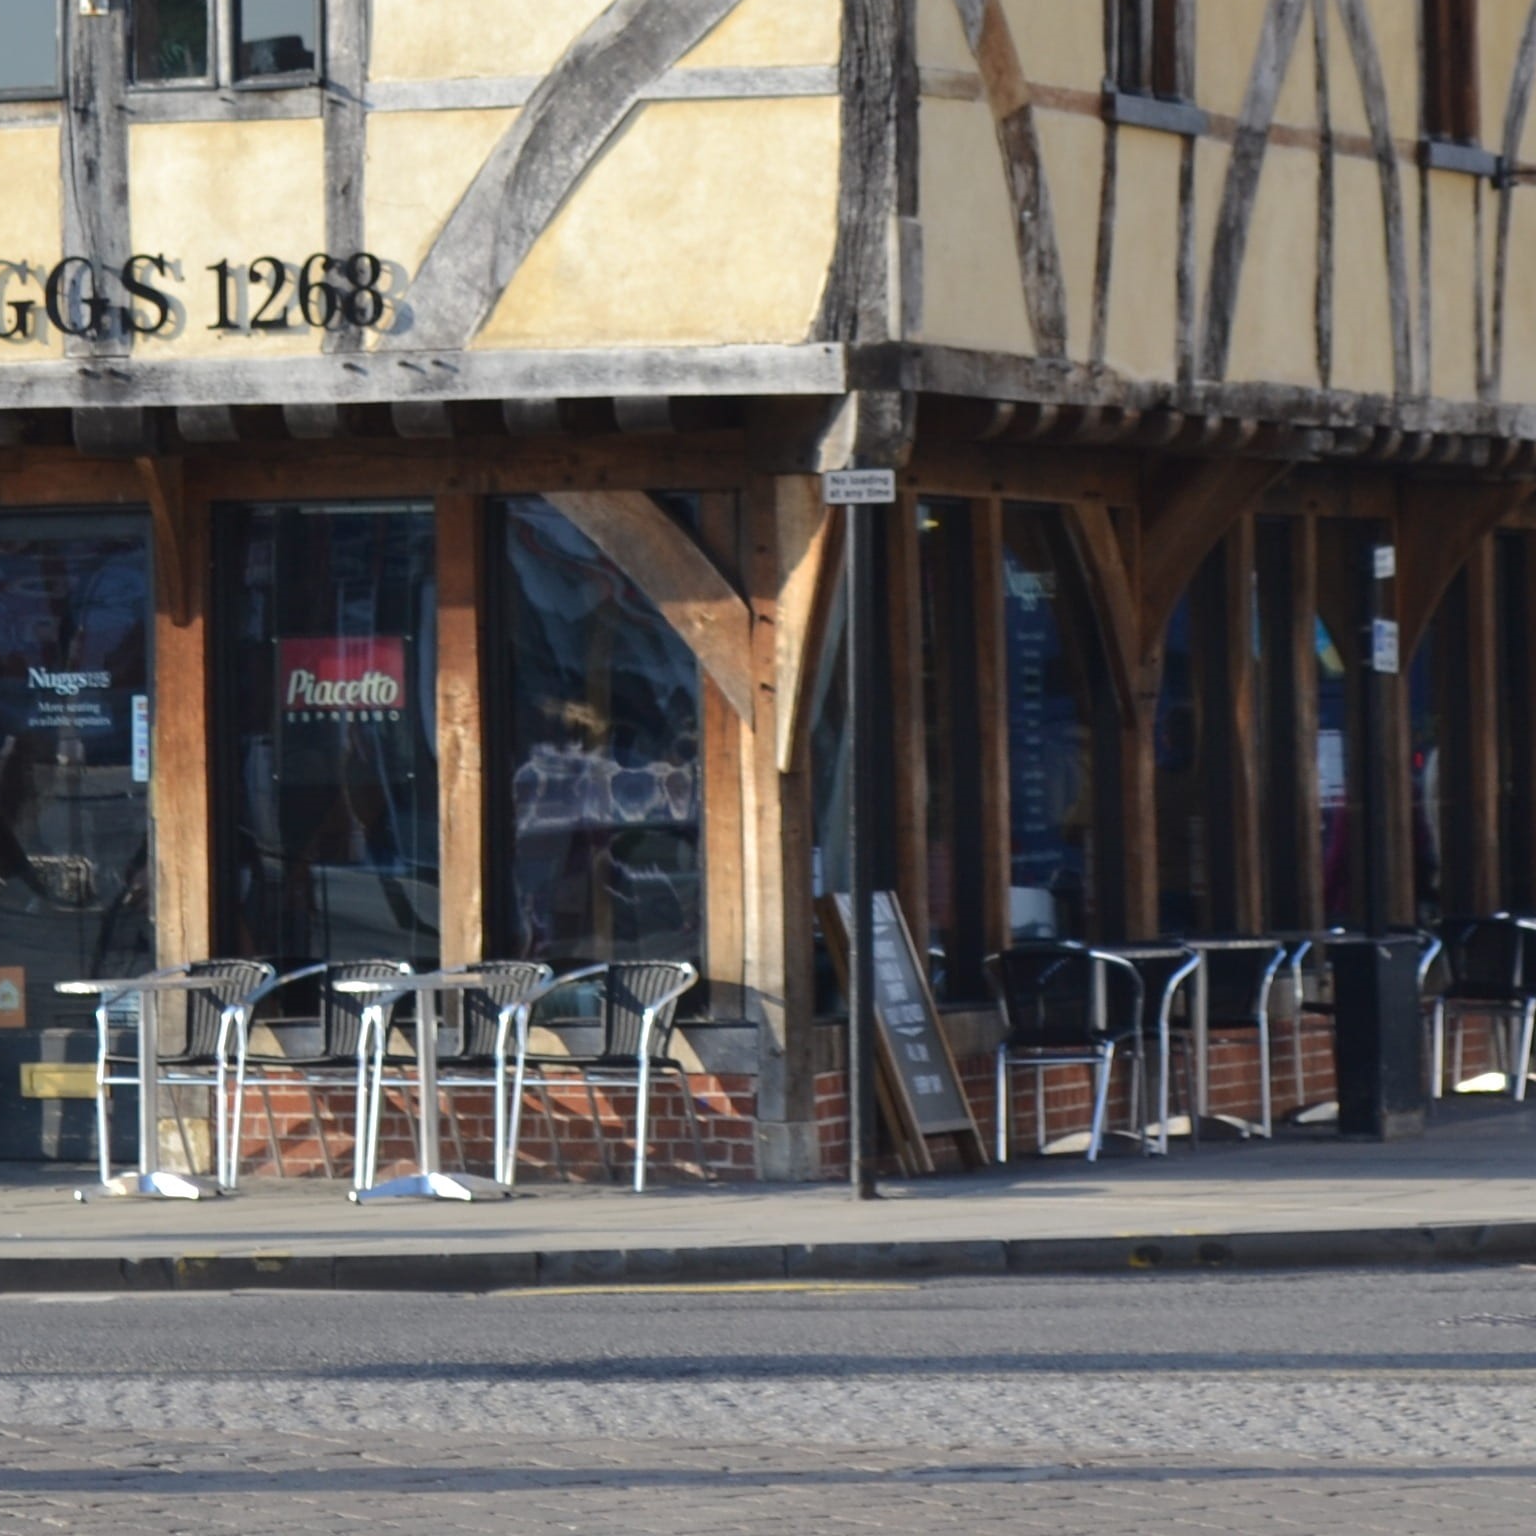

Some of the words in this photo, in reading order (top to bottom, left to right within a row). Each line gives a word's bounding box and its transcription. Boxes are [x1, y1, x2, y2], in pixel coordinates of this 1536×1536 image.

[206, 252, 385, 331] 1268
[28, 667, 87, 695] Nuggs
[287, 669, 398, 706] Piacetto
